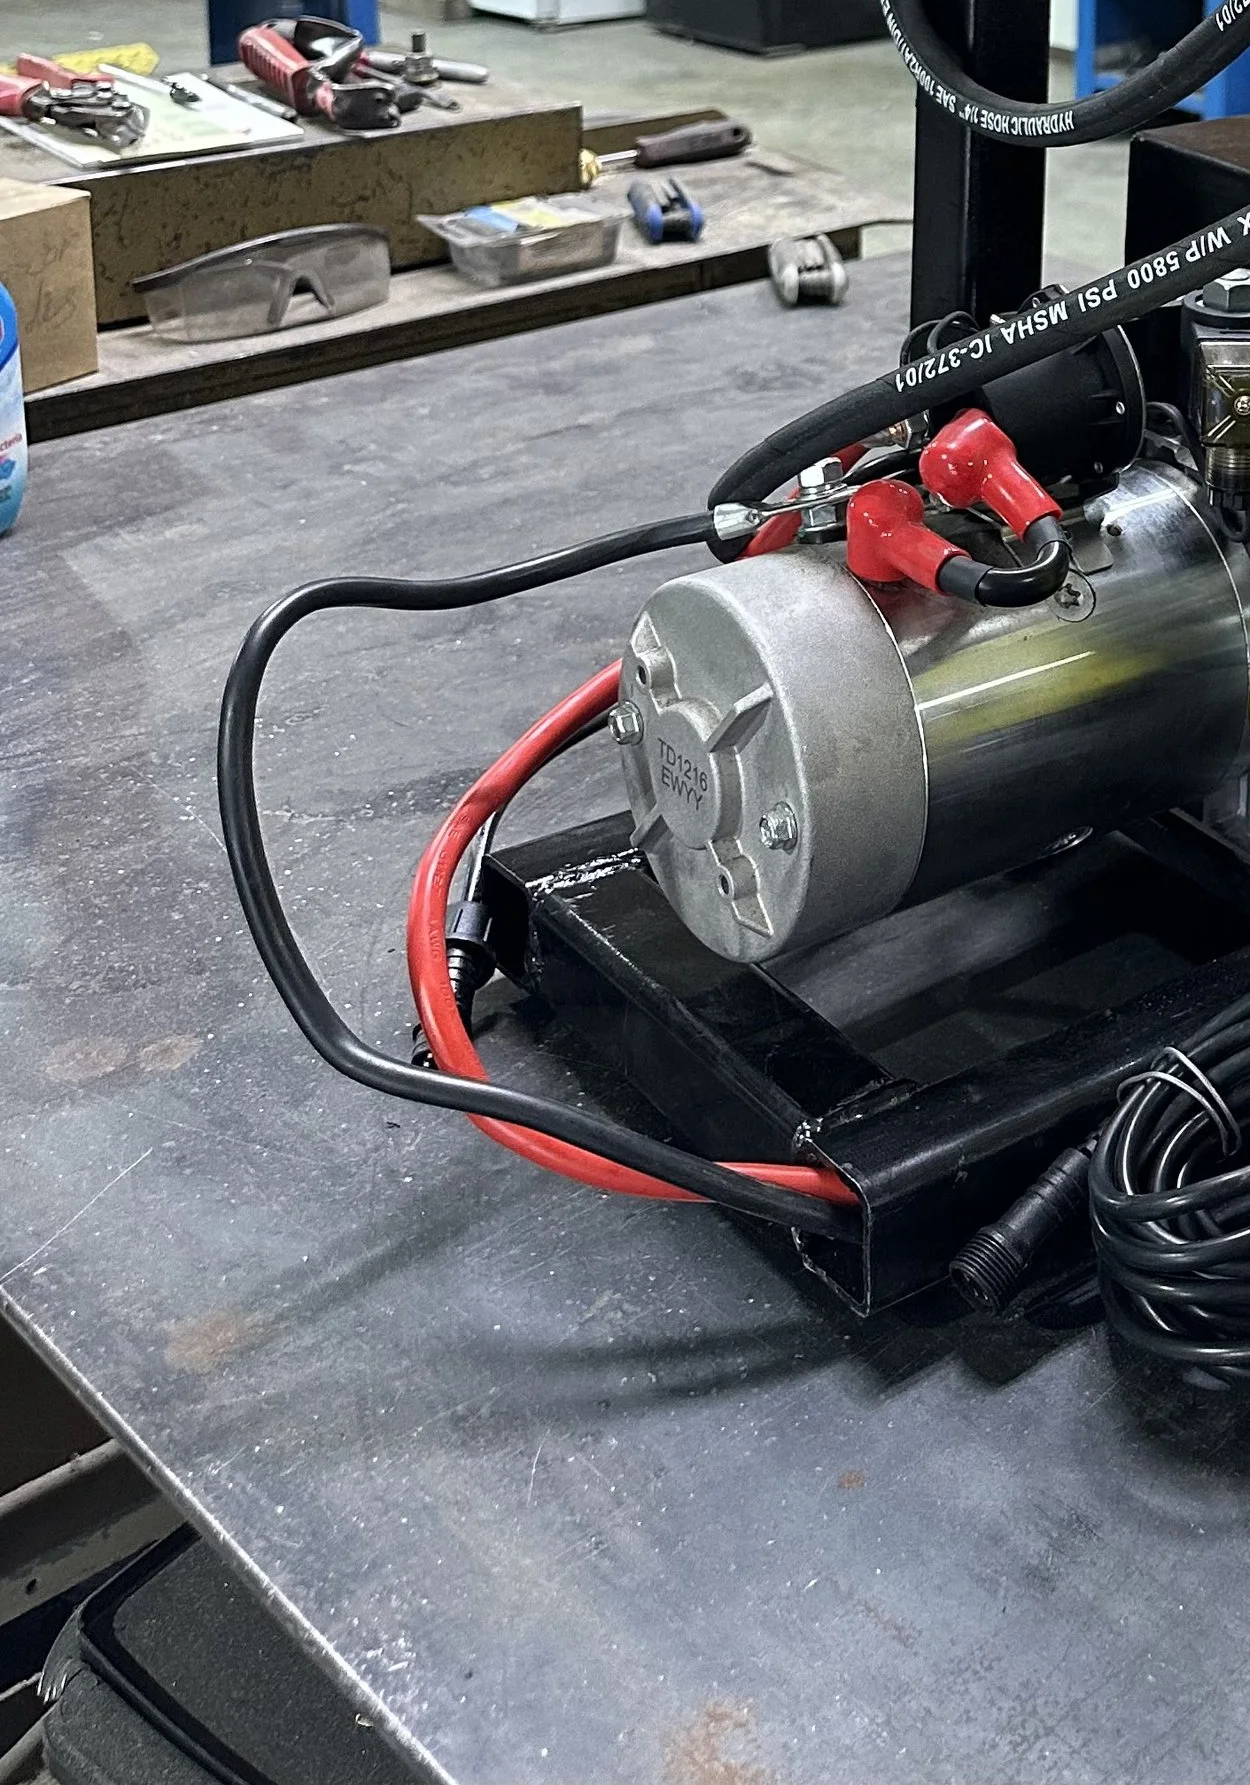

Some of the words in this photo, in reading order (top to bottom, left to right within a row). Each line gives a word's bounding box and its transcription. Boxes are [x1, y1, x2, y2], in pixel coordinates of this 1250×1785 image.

[935, 85, 957, 113] SAE
[981, 109, 1010, 134] HOSE
[1010, 109, 1075, 137] HYDRAULIC
[1185, 226, 1232, 263] W/P
[1127, 250, 1180, 289] 5800
[1078, 279, 1118, 312] PSI
[1000, 300, 1069, 345] MSHA
[895, 333, 993, 393] IC-372/01
[658, 737, 708, 792] TD1216
[662, 764, 703, 811] EWYY
